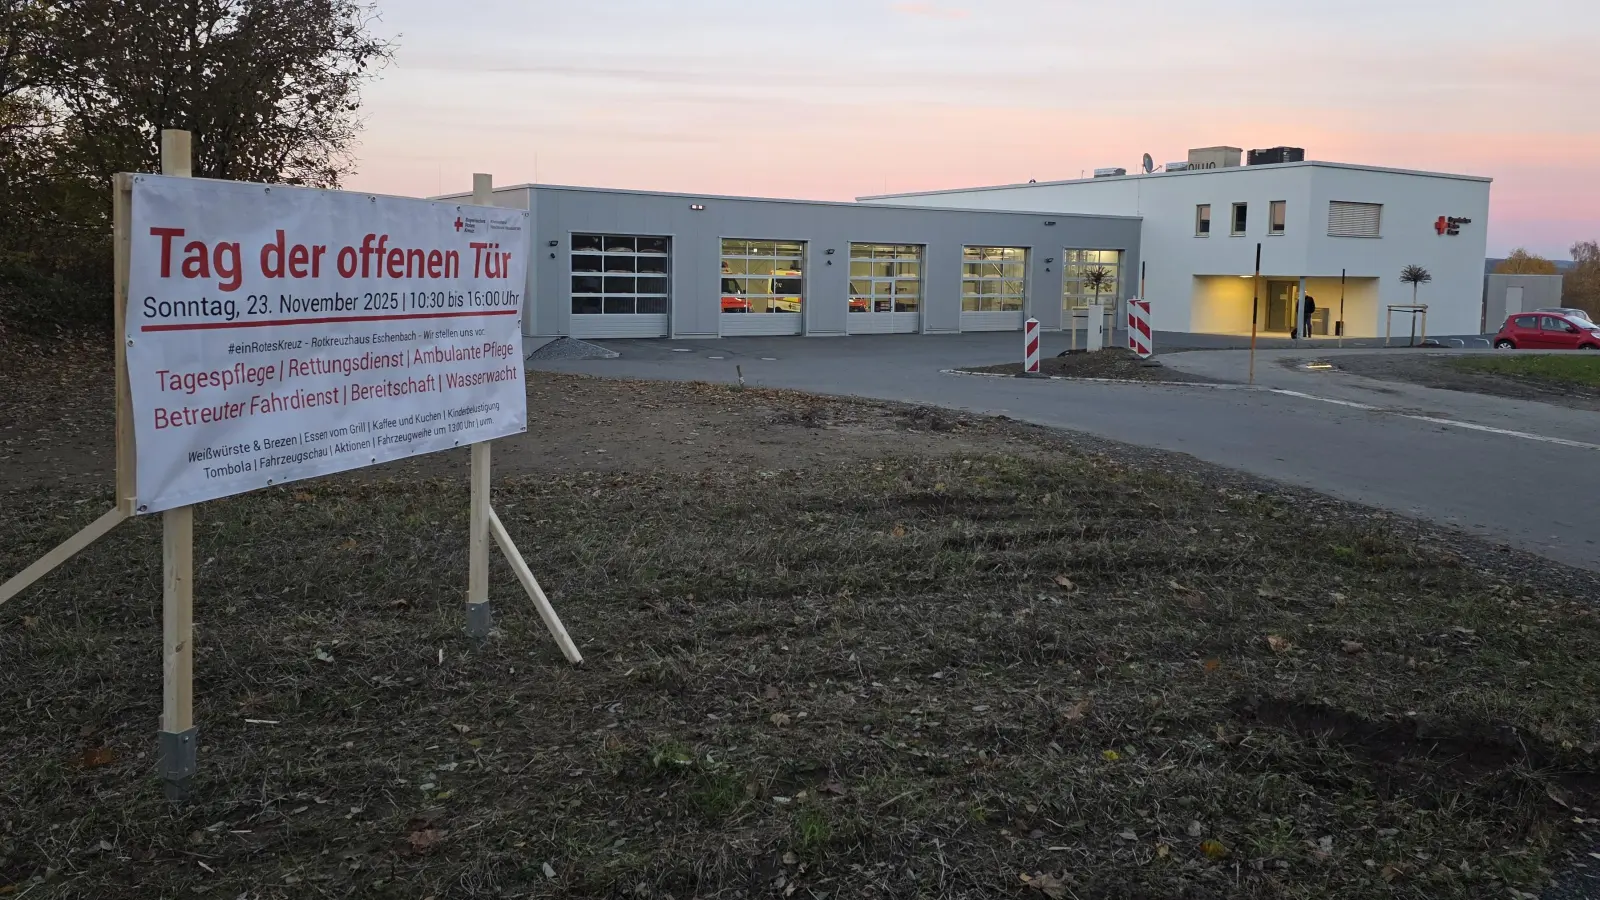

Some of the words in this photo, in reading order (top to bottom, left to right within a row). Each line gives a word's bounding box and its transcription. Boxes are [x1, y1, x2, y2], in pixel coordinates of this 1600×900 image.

[150, 226, 243, 292] Tag
[260, 229, 326, 279] der
[337, 233, 459, 279] offenen
[469, 242, 512, 279] Tür
[143, 296, 240, 321] Sonntag,
[247, 294, 272, 315] 23.
[280, 292, 358, 314] November
[363, 292, 398, 310] 2025
[410, 291, 445, 309] 10:30
[448, 290, 464, 307] bis
[468, 290, 500, 307] 16:00
[501, 289, 520, 306] Uhr
[155, 362, 275, 394] Tagespflege
[288, 352, 404, 378] Rettungsdienst
[413, 344, 481, 365] Ambulante
[483, 341, 514, 360] Pflege
[228, 339, 302, 355] #einRotesKreuz
[311, 334, 370, 348] Rotkreuzhaus
[372, 330, 417, 344] Eschenbach
[423, 329, 434, 339] Wir
[435, 328, 459, 339] stellen
[459, 329, 474, 337] uns
[154, 401, 246, 430] Betreuter
[250, 387, 339, 416] Fahrdienst
[351, 373, 435, 402] Bereitschaft
[446, 365, 517, 389] Wasserwacht
[188, 442, 251, 463] Weißwürste
[253, 440, 261, 451] &
[263, 436, 298, 450] Brezen
[304, 431, 328, 443] Essen
[329, 427, 348, 438] vom
[349, 421, 366, 434] Grill
[372, 418, 397, 431] Kaffee
[399, 414, 414, 426] und
[415, 411, 442, 424] Kuchen
[447, 402, 500, 418] Kinderbelustigung
[203, 462, 252, 479] Tombola
[260, 446, 328, 469] Fahrzeugschau
[334, 439, 371, 454] Aktionen
[377, 427, 432, 446] Fahrzeugweihe
[433, 426, 446, 435] um
[464, 419, 475, 429] Uhr
